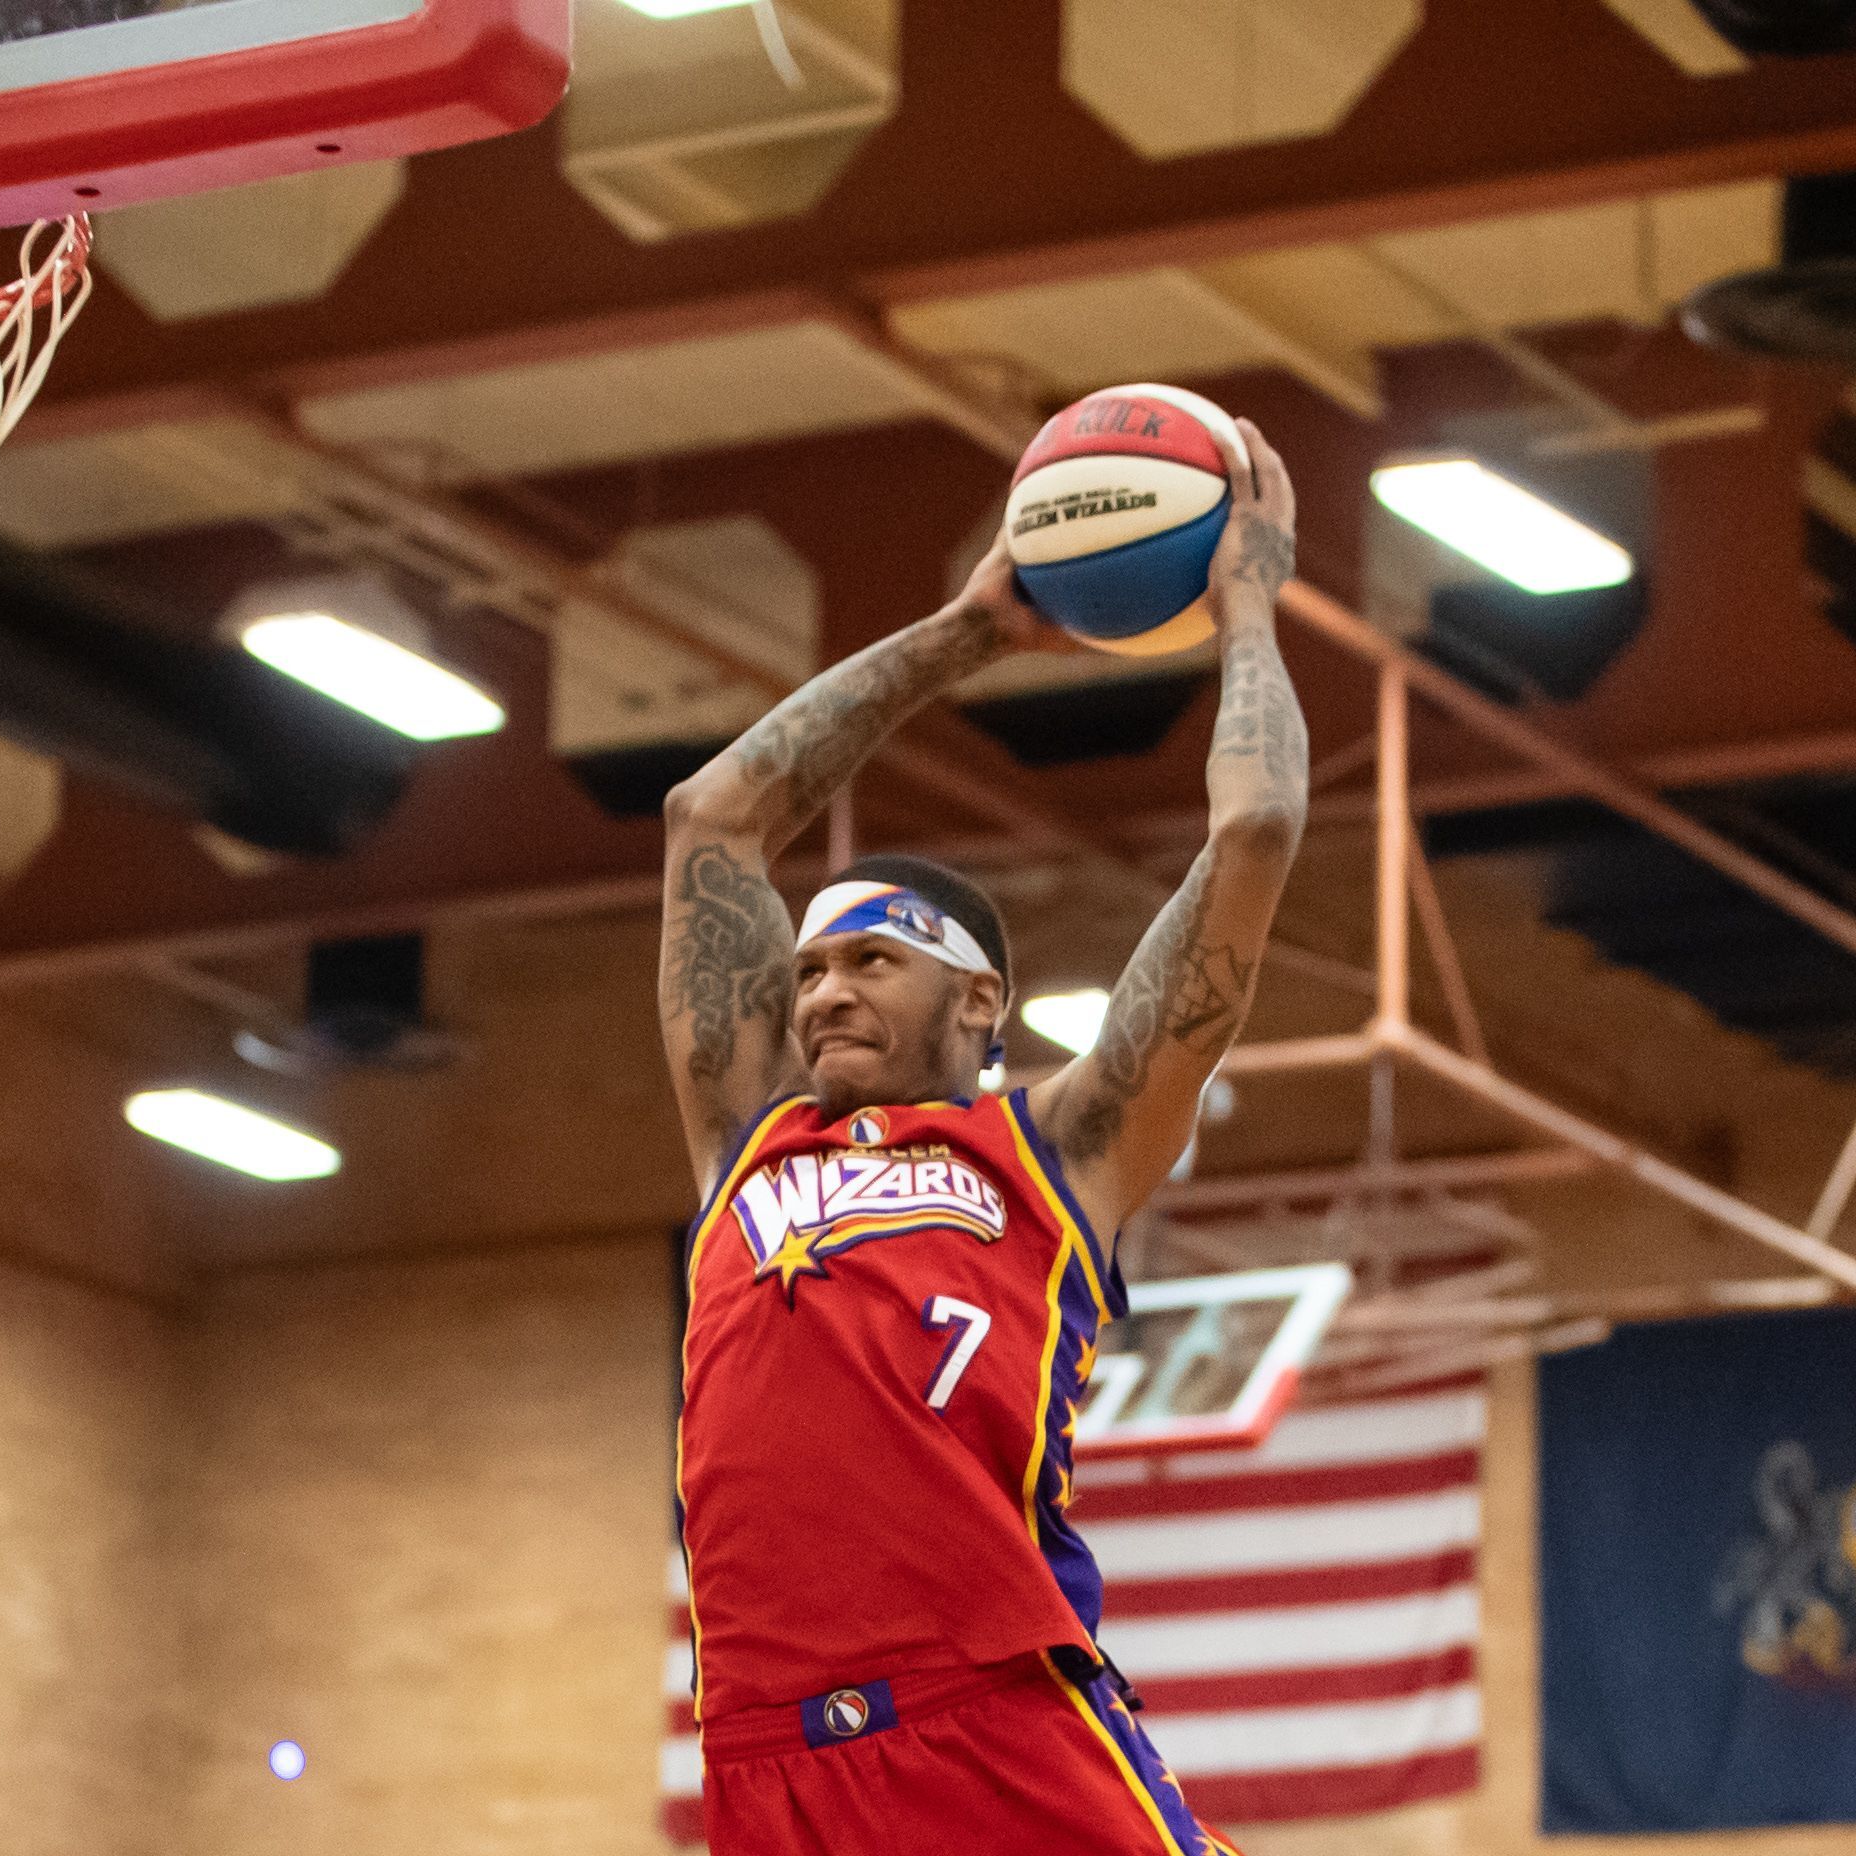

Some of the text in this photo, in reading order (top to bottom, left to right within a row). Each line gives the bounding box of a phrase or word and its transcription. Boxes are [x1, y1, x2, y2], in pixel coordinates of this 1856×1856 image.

[1064, 492, 1156, 520] WIZARDS
[732, 1152, 1006, 1268] WIZARDS
[923, 1294, 992, 1414] 7
